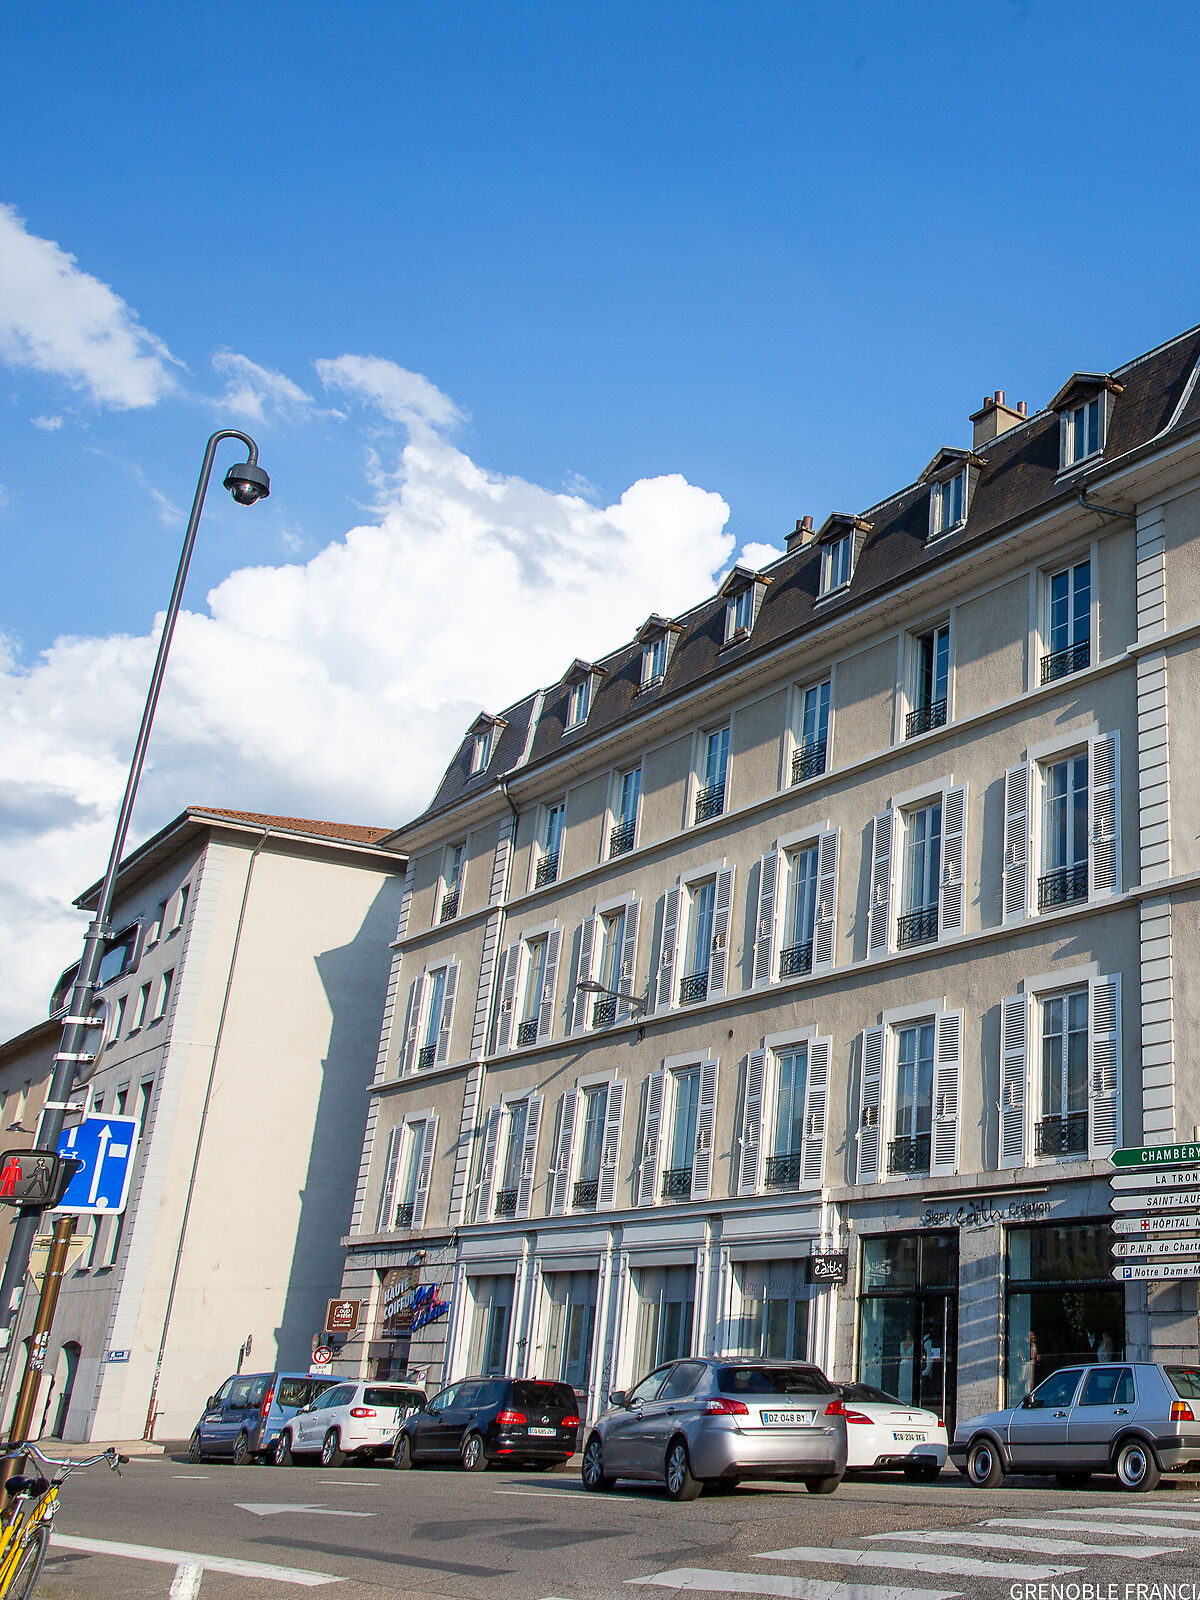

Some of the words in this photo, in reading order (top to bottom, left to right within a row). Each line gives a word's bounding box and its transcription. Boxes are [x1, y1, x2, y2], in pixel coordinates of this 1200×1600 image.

[1156, 1175, 1167, 1184] LA
[1152, 1217, 1190, 1228] HÔPITAL
[1130, 1244, 1155, 1253] P.N.R.
[1160, 1243, 1169, 1252] de
[1134, 1267, 1159, 1276] Notre
[384, 1276, 409, 1304] HAUTE
